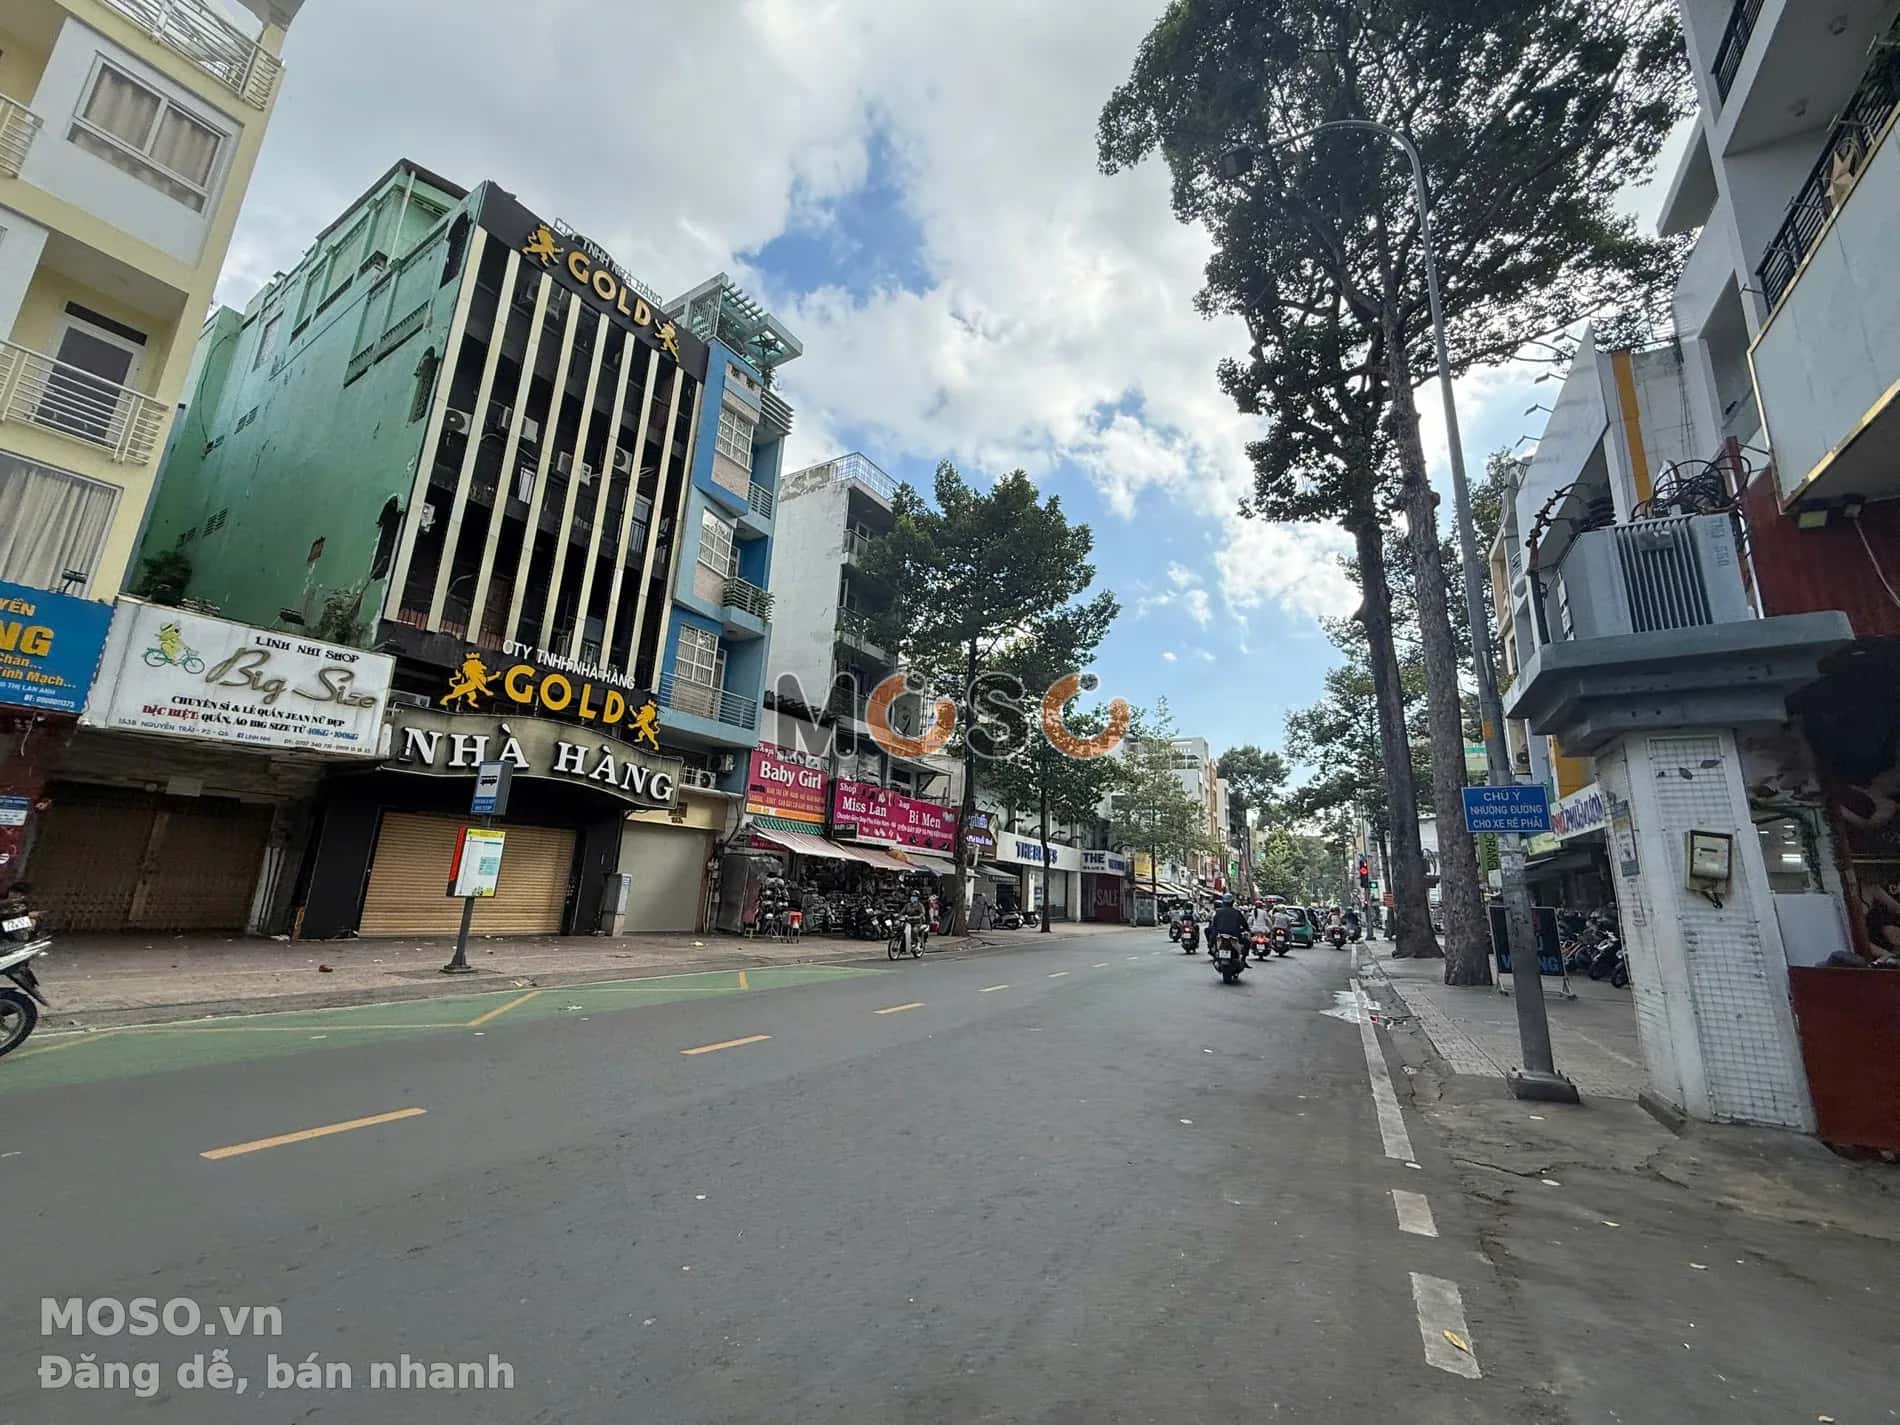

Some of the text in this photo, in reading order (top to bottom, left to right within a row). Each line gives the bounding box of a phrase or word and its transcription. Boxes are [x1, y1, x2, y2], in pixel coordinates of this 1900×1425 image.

[567, 250, 652, 327] GOLD
[255, 635, 360, 664] LINH NHI SHOP
[205, 647, 378, 709] Big Size
[537, 648, 570, 672] TNHH
[572, 661, 599, 681] NHÀ
[601, 669, 636, 690] HÀNG
[504, 664, 626, 724] GOLD
[171, 695, 217, 710] CHUYÊN
[231, 704, 240, 713] &
[285, 712, 312, 724] JEAN
[233, 717, 248, 728] ÁO
[249, 719, 267, 729] BIG
[268, 722, 291, 732] SIZE
[399, 723, 675, 801] NHÀ HÀNG
[759, 761, 823, 790] Baby Girl
[839, 782, 858, 796] Shop
[1483, 789, 1521, 801] CHÚ Ý
[842, 796, 867, 813] Miss
[868, 802, 887, 817] Lan
[908, 809, 919, 825] Bi
[921, 812, 942, 830] Men
[1472, 819, 1494, 829] CHO
[1493, 819, 1505, 829] XE
[1520, 815, 1543, 829] PHẢI
[1082, 852, 1106, 864] THE
